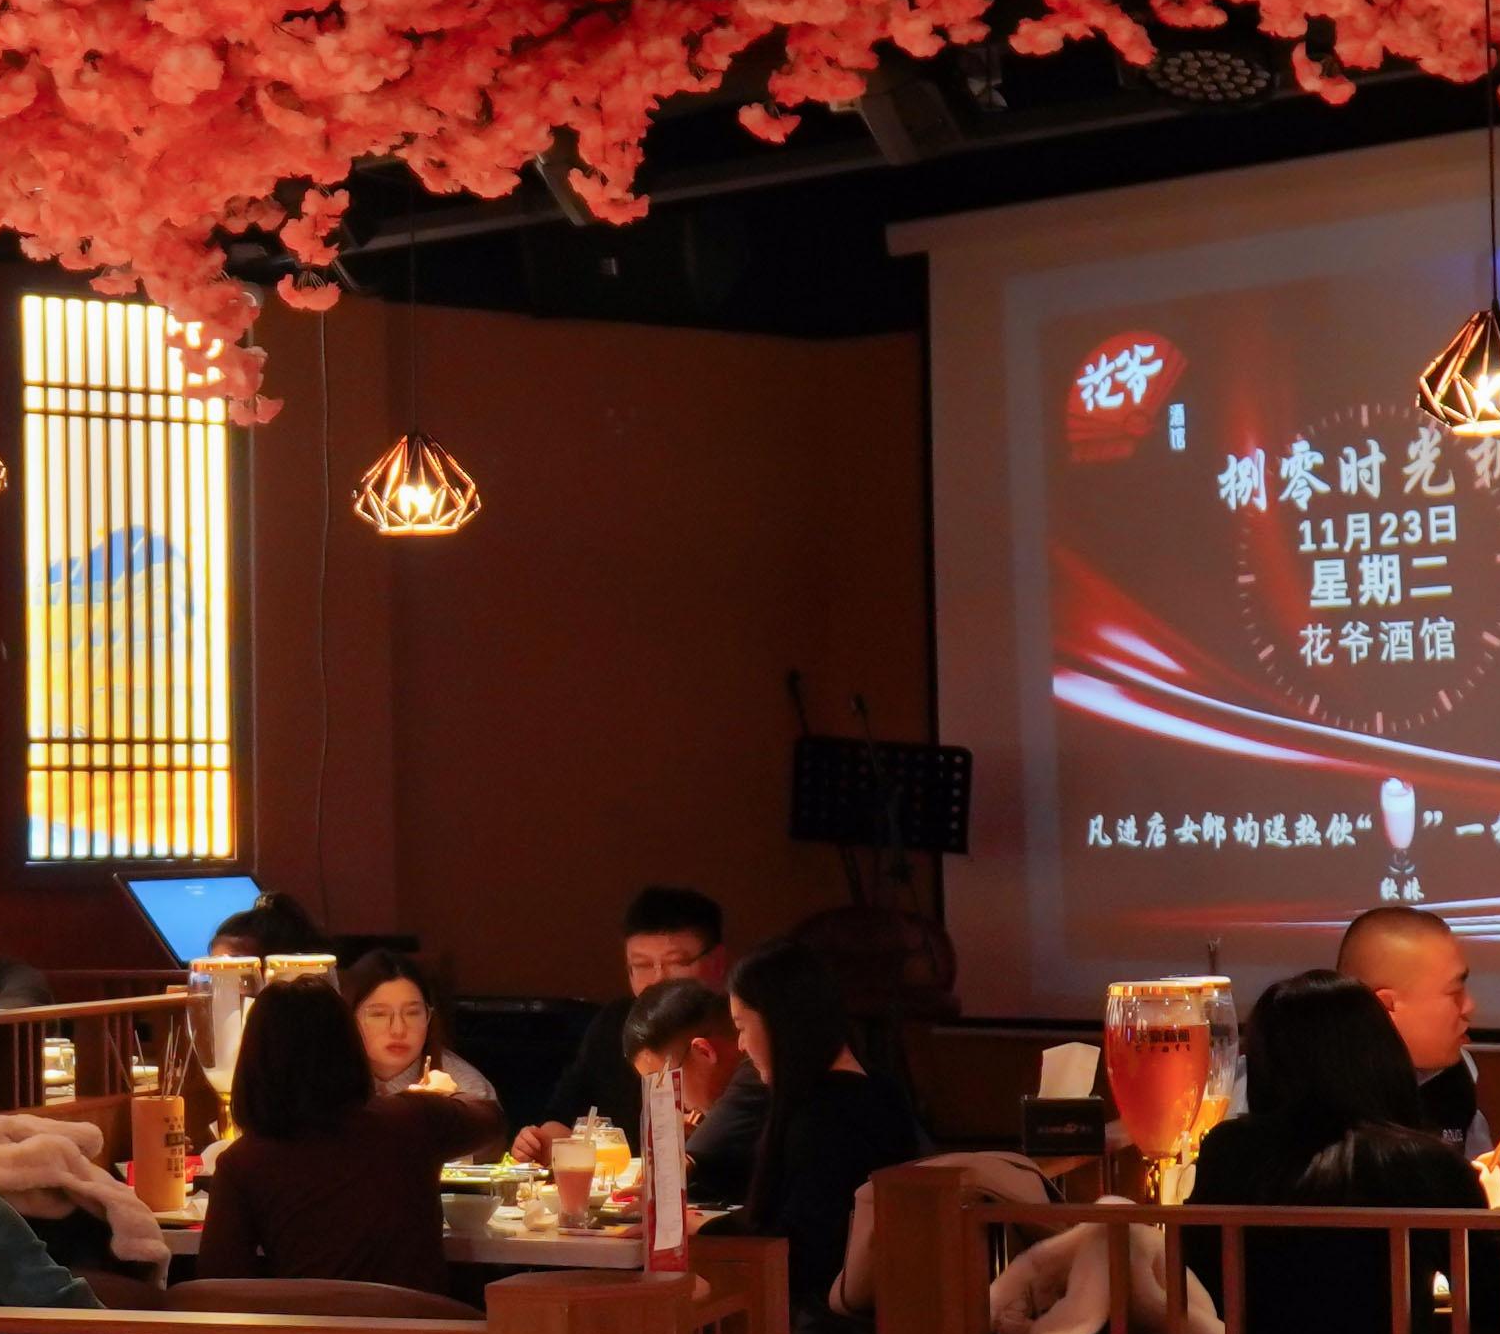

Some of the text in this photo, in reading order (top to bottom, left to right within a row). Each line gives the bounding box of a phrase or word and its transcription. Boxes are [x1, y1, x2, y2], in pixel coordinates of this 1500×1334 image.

[1299, 505, 1457, 553] 11月23日
[1309, 553, 1453, 608] 星期二
[1299, 617, 1456, 667] 花爷酒馆
